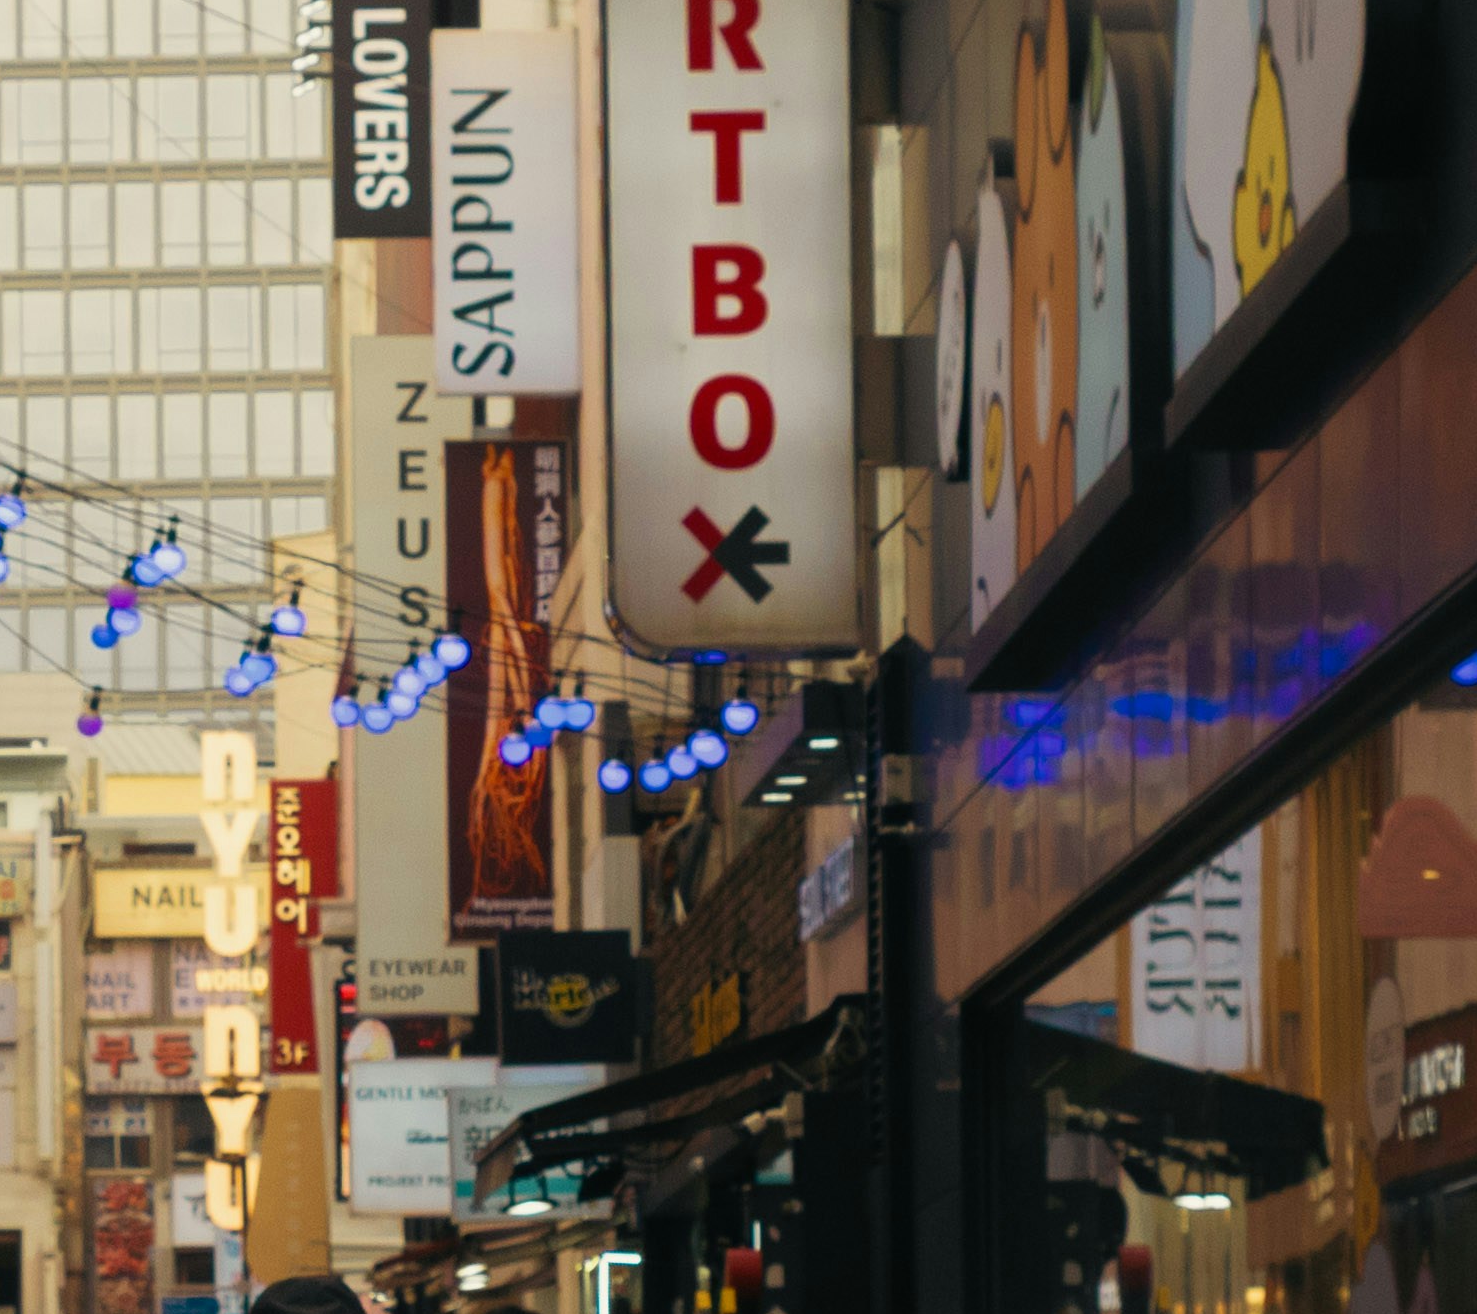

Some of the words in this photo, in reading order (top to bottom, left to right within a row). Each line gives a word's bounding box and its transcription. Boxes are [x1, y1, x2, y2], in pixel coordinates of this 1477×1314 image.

[352, 8, 410, 211] LOVERS
[451, 89, 515, 378] SAPPUN
[395, 382, 430, 626] ZEUS
[132, 886, 202, 908] NAIL
[472, 898, 554, 914] Myeongdon
[196, 968, 269, 991] WORLD
[369, 959, 466, 978] EYEWEAR
[369, 985, 424, 1002] SHOP
[92, 1033, 196, 1077] 부동
[276, 1039, 309, 1066] 3F
[356, 1086, 413, 1101] GENTLE
[421, 1086, 449, 1101] MO
